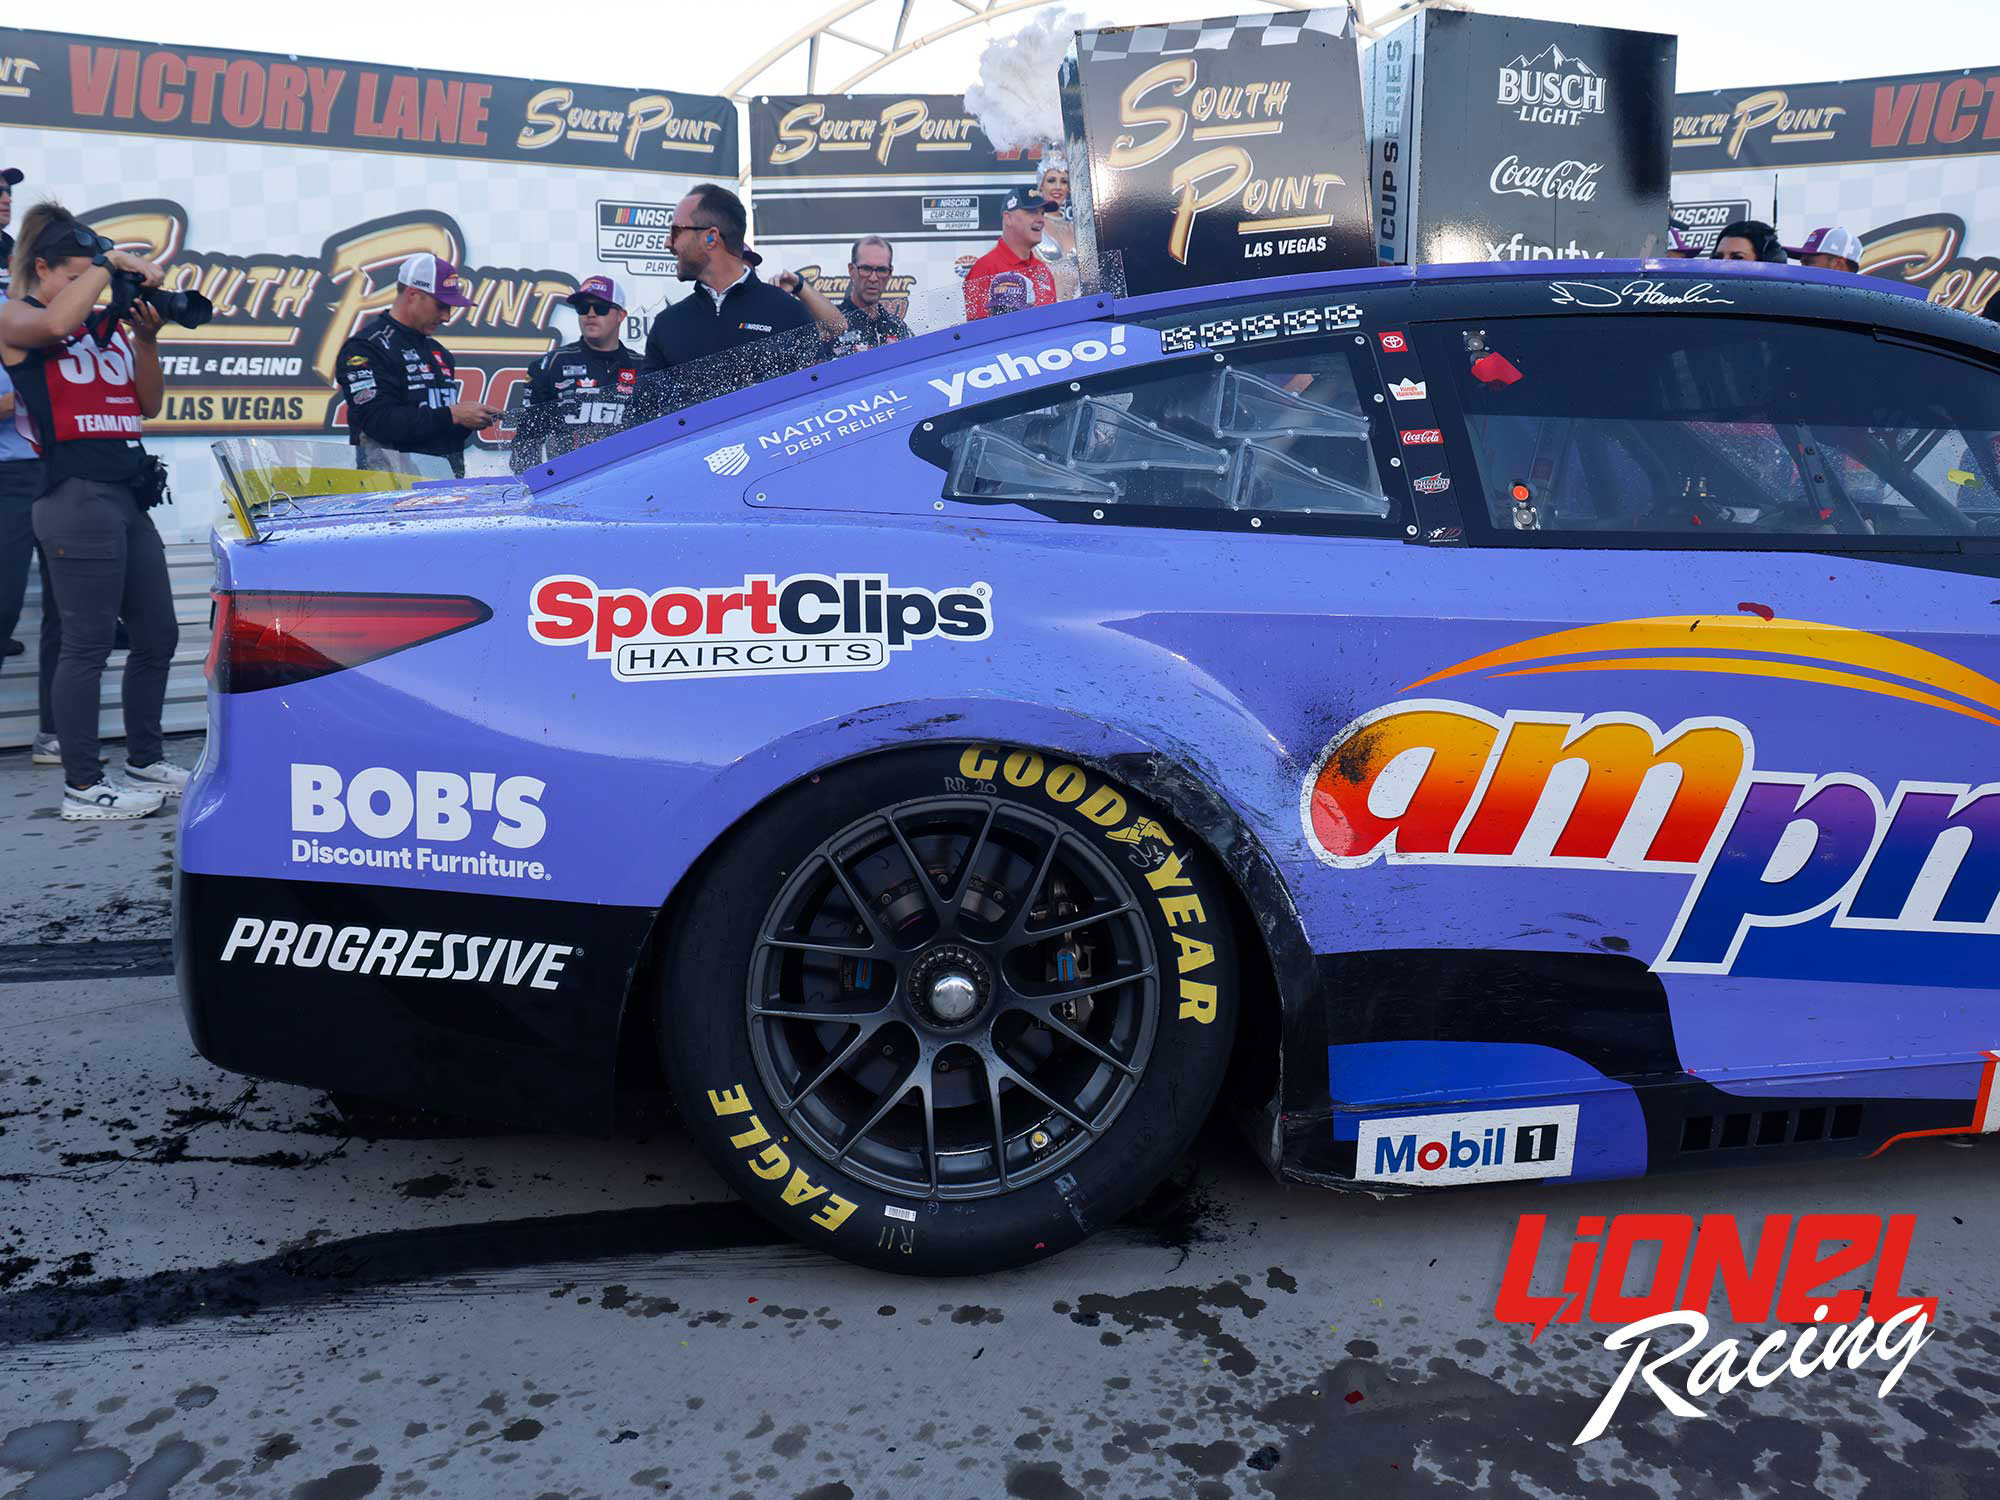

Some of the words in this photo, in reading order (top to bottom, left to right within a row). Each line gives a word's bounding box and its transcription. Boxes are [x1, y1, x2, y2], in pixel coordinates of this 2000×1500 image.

[68, 44, 346, 133] VICTORY
[353, 71, 493, 147] LANE
[1106, 57, 1292, 170] SOUTH
[1384, 39, 1402, 163] SERIES
[1497, 67, 1607, 114] BUSCH
[1518, 106, 1581, 126] LIGHT
[516, 87, 625, 149] SOUTH
[625, 95, 722, 160] POINT
[769, 103, 877, 165] SOUTH
[876, 100, 985, 166] POINT
[1727, 90, 1846, 160] POINT
[940, 198, 971, 208] NASCAR
[1380, 170, 1398, 240] CUP
[1489, 154, 1604, 202] Coca-Cola
[1168, 145, 1346, 266] POINT
[1673, 206, 1730, 225] ASCAR
[614, 232, 643, 249] CUP
[1244, 242, 1272, 258] LAS
[1278, 236, 1327, 255] VEGAS
[204, 358, 217, 373] &
[219, 356, 302, 376] CASINO
[928, 325, 1127, 408] yahoo!
[1182, 340, 1196, 351] 16
[166, 396, 214, 421] LAS
[222, 396, 303, 421] VEGAS
[758, 389, 908, 449] NATIONAL
[785, 430, 832, 456] DEBT
[836, 407, 897, 437] RELIEF
[535, 578, 988, 653] SportClips
[628, 643, 872, 670] HAIRCUTS
[290, 763, 548, 849] BOB'S
[291, 838, 412, 869] Discount
[220, 917, 574, 991] PROGRESSIVE
[707, 1083, 859, 1232] EAGLE
[1374, 1127, 1507, 1175] Mobil
